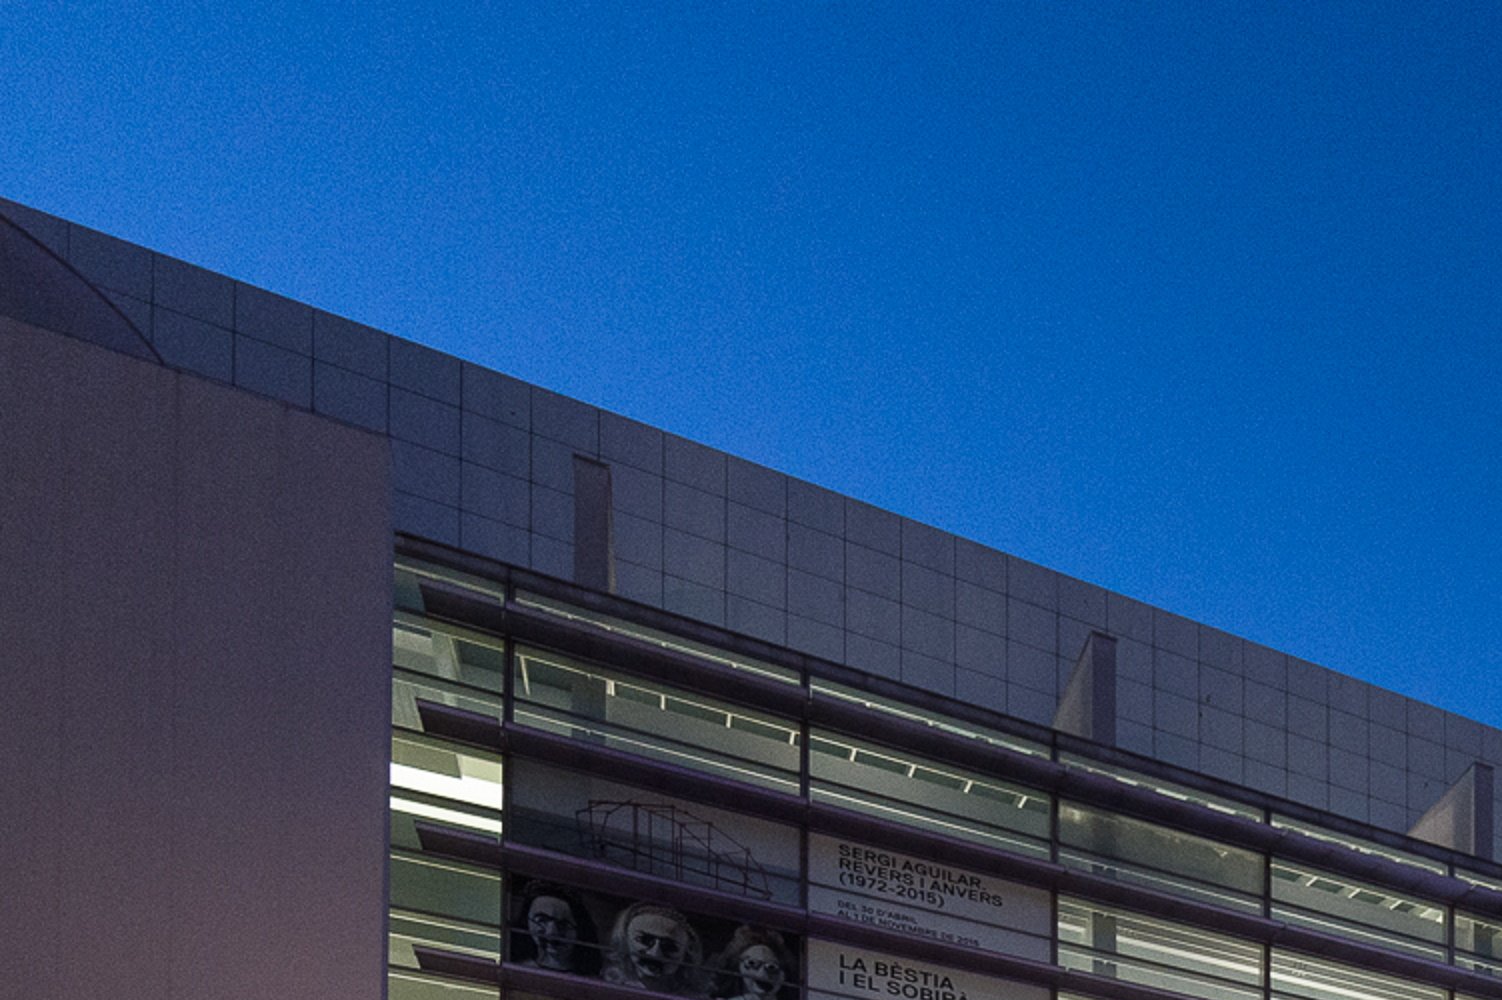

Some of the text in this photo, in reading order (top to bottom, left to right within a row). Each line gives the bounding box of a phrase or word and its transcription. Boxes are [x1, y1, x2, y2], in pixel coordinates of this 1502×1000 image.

[839, 844, 986, 890] SERGI AGUILAR.
[839, 858, 1003, 907] REVERS I ANVERS
[838, 900, 857, 911] DEL
[839, 872, 944, 908] (1972-2015)
[840, 954, 954, 990] LA BÈSTIA
[840, 971, 845, 985] I
[853, 973, 880, 992] EL
